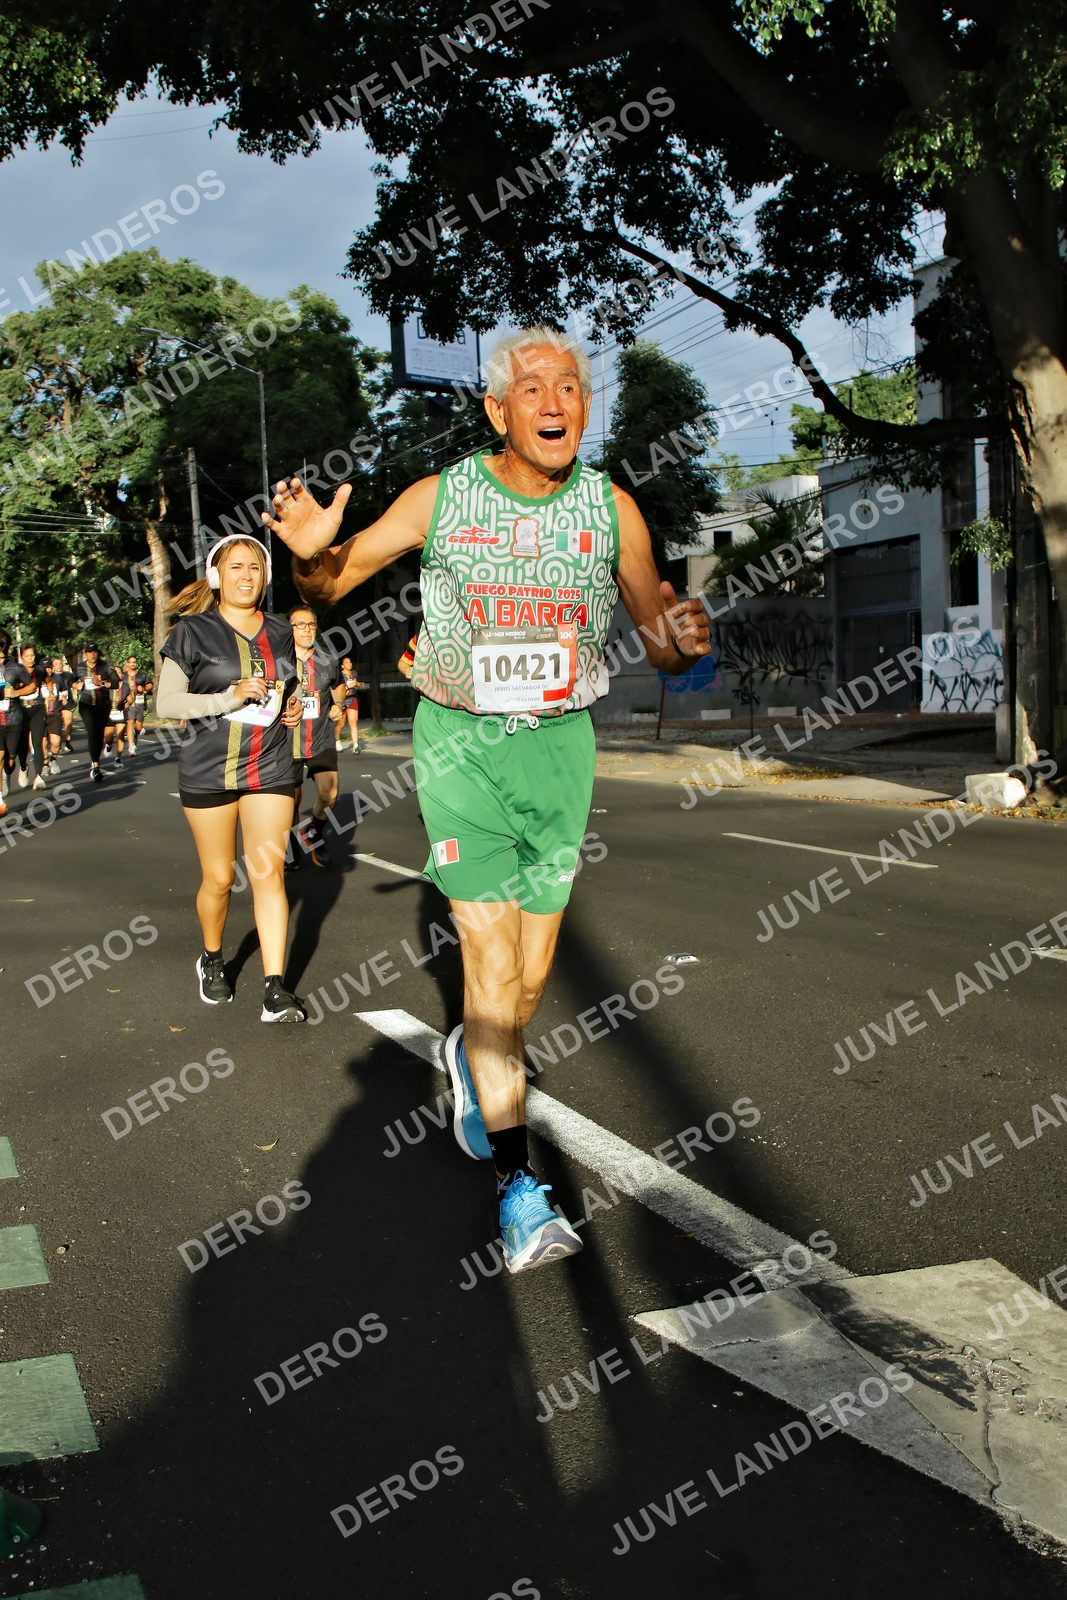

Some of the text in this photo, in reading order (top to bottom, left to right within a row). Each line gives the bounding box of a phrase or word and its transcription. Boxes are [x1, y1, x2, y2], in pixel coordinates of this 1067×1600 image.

[448, 535, 500, 545] GERSO
[466, 583, 581, 600] FUEGO PATRIO 2025
[463, 597, 588, 629] A BARCA
[478, 653, 560, 682] 10421
